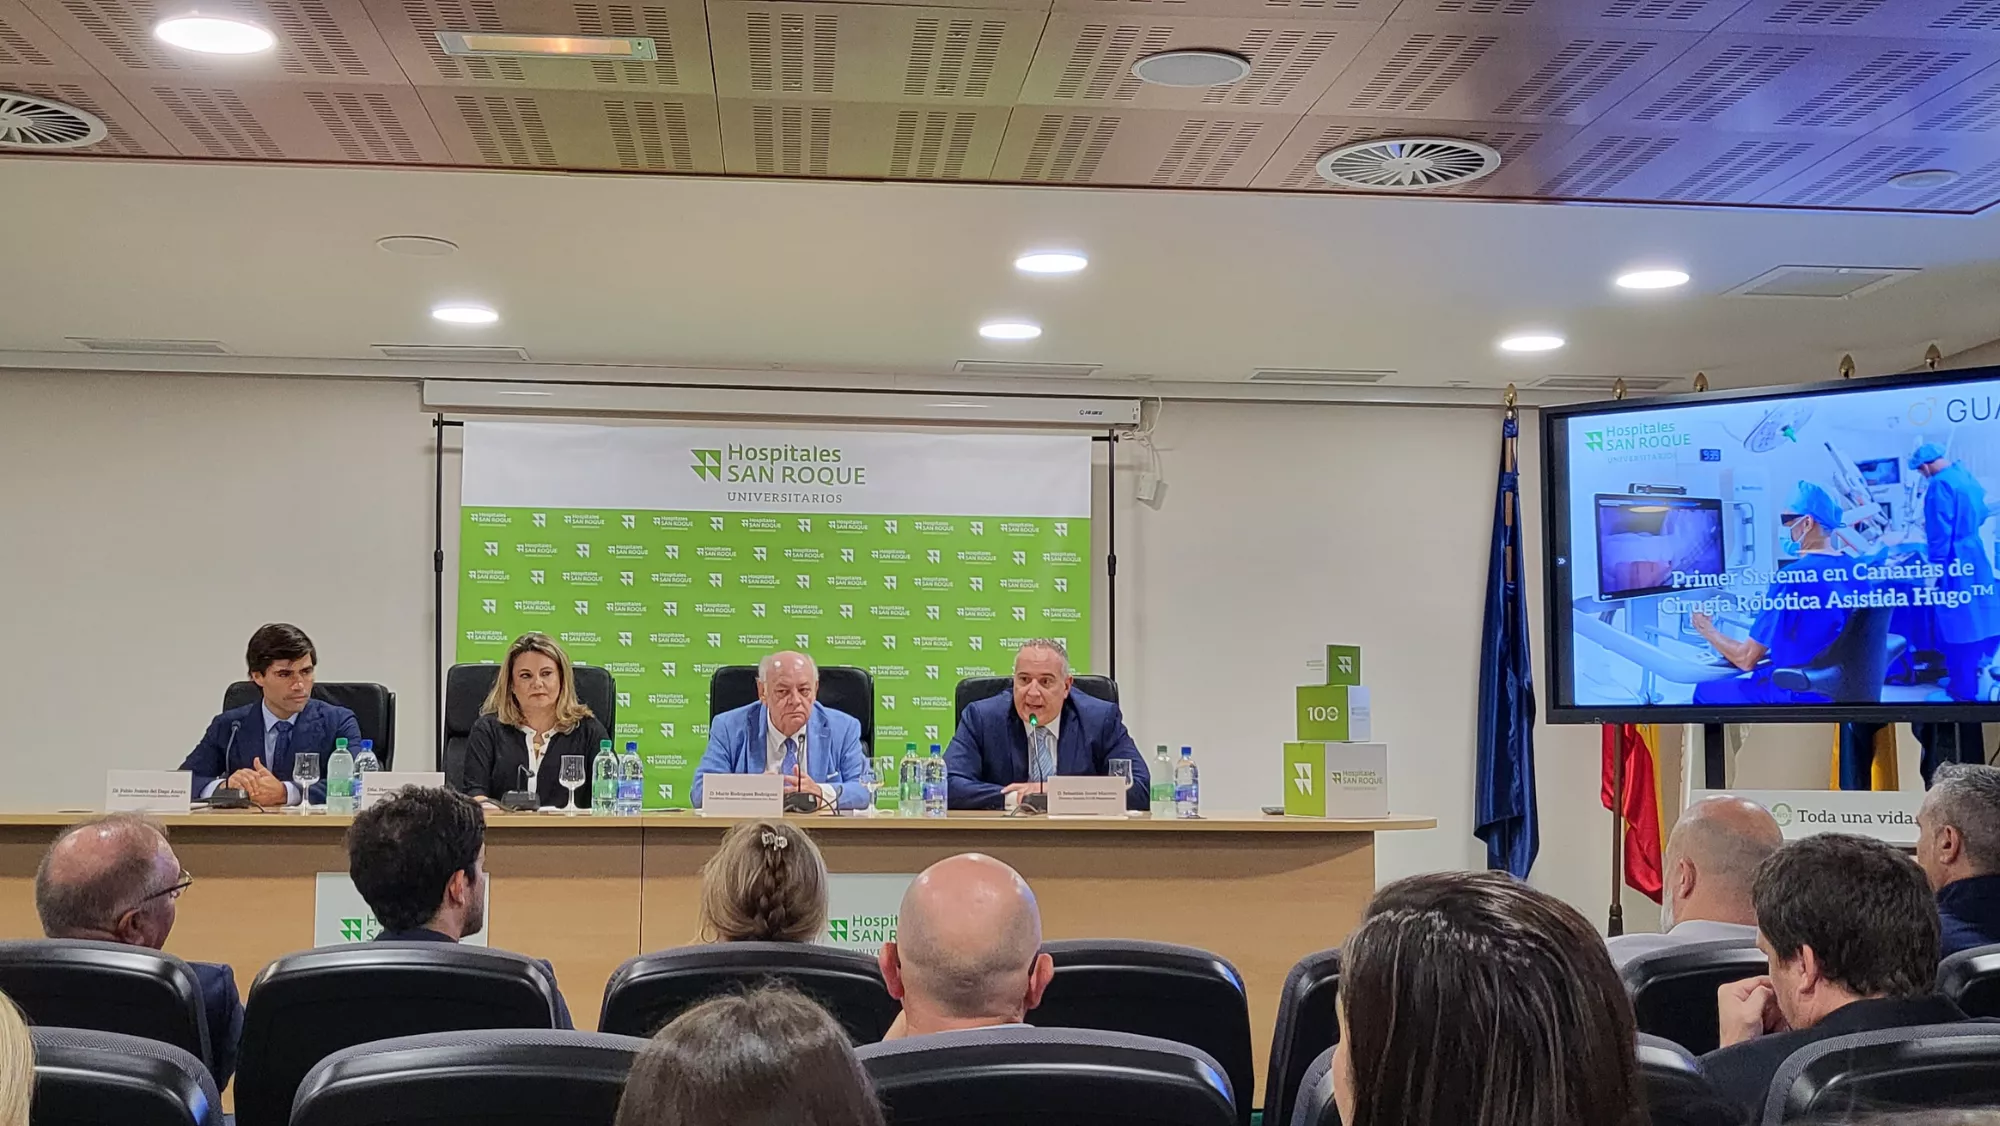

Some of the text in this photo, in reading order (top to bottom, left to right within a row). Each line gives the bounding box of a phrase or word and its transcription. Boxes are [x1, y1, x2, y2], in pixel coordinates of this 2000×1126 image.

[1946, 396, 2000, 423] GU
[1606, 422, 1675, 437] Hospitales
[1606, 433, 1692, 451] SAN ROQUE
[728, 443, 841, 465] Hospitales
[727, 465, 866, 486] SAN ROQUE
[727, 492, 842, 503] UNIVERSITARIOS
[1671, 558, 1975, 588] Primer Sistema en Canarias de
[1661, 595, 1731, 616] Cirugía
[1735, 592, 1821, 611] Robótica
[1824, 588, 1909, 609] Asistida
[1307, 706, 1339, 721] 100
[1358, 777, 1383, 785] ROQUE
[1797, 810, 1836, 823] Toda
[1841, 813, 1873, 823] una
[852, 914, 898, 929] Hospit
[852, 930, 884, 942] SAN
